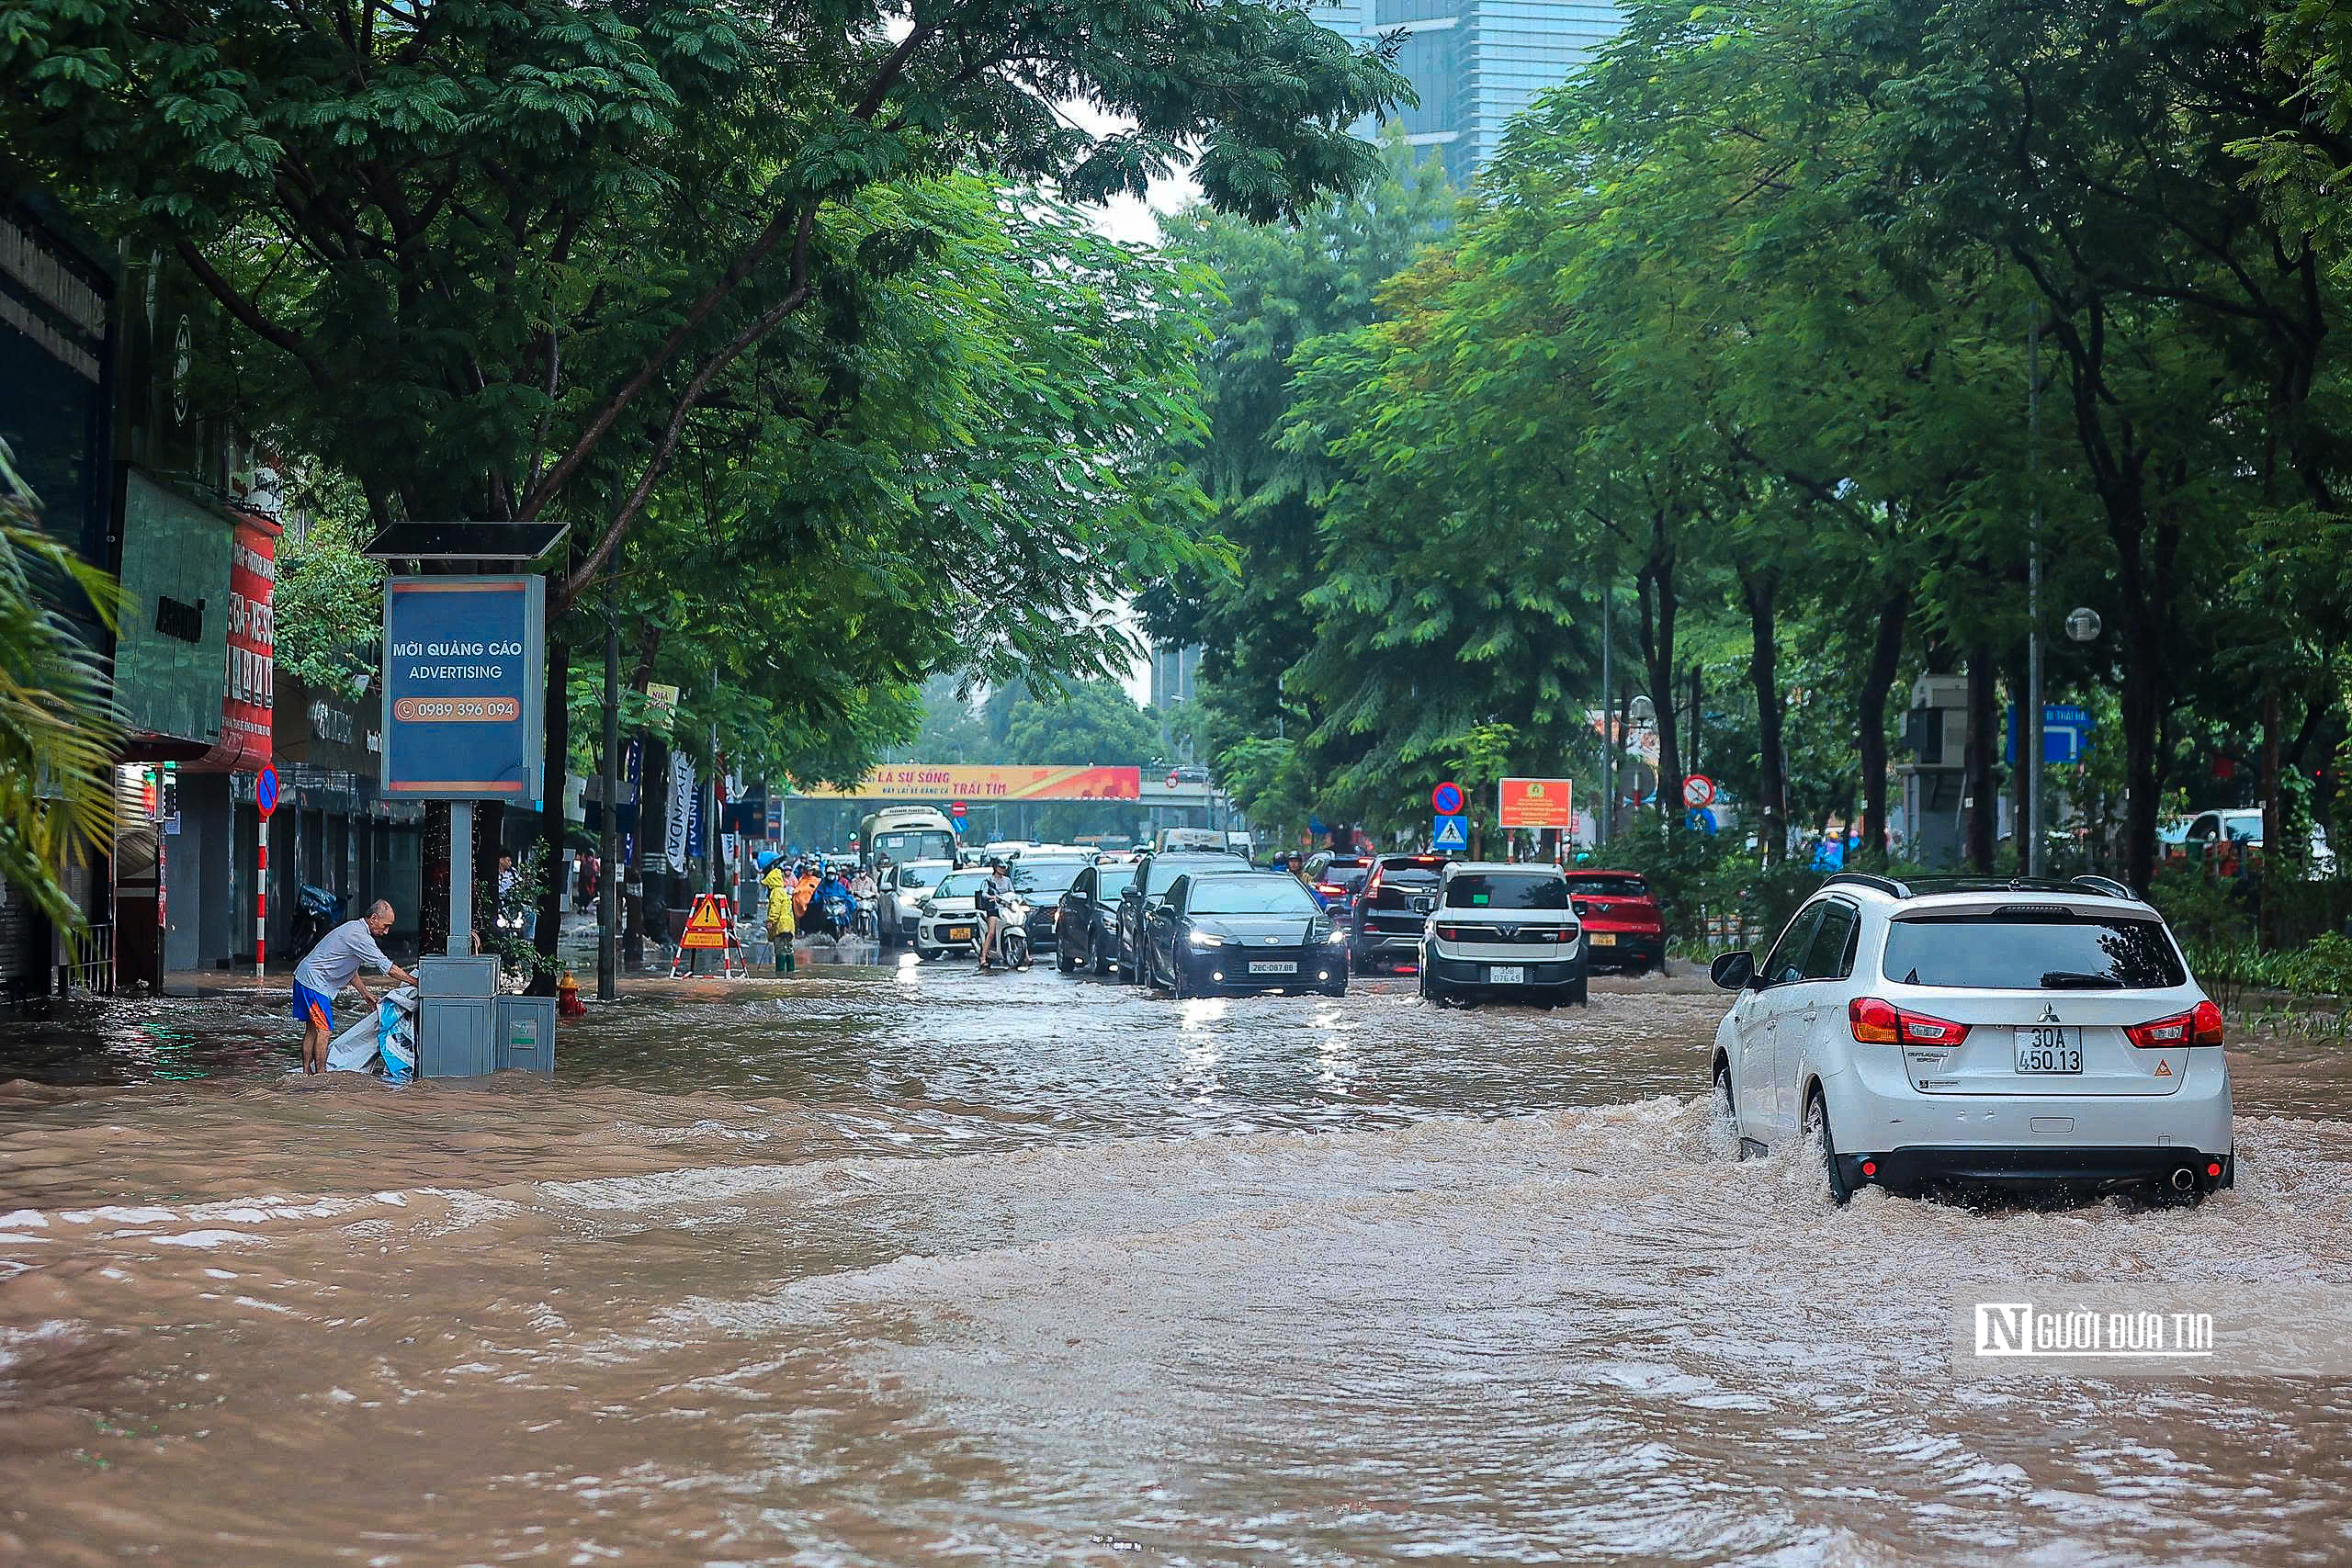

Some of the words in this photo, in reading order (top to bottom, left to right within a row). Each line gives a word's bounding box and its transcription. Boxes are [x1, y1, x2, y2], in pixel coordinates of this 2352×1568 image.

[392, 640, 423, 657] MỜI
[426, 639, 484, 657] QUẢNG
[488, 639, 522, 656] CÁO
[408, 665, 503, 679] ADVERTISING
[417, 703, 453, 716] 0989
[457, 703, 484, 716] 396
[487, 703, 514, 716] 094
[985, 783, 1008, 795] TIM
[668, 765, 688, 858] HYUNDAI
[2030, 1028, 2066, 1048] 30A
[2018, 1050, 2080, 1071] 450.13
